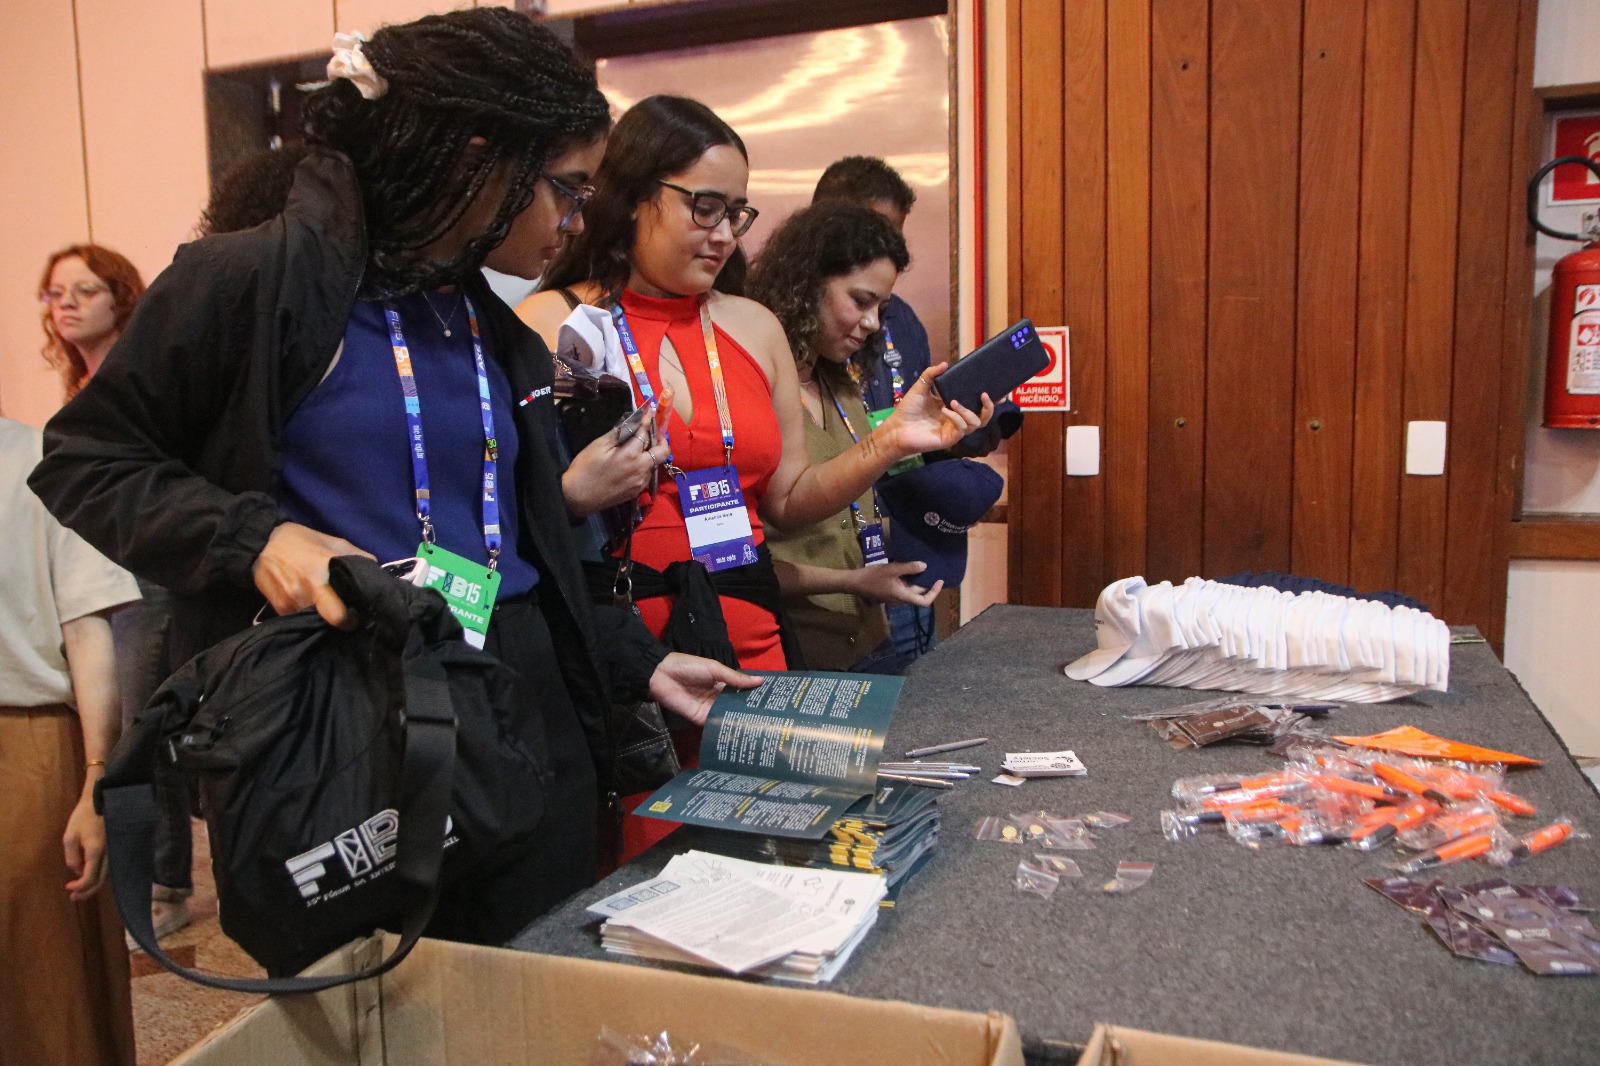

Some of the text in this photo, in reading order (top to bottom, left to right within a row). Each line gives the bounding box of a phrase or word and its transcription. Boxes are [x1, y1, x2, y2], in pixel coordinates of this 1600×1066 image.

[1016, 386, 1063, 395] ALARME DE
[1019, 393, 1060, 404] INCÊNDIO
[689, 498, 740, 514] PARTICIPANTE
[448, 604, 485, 624] RANTE
